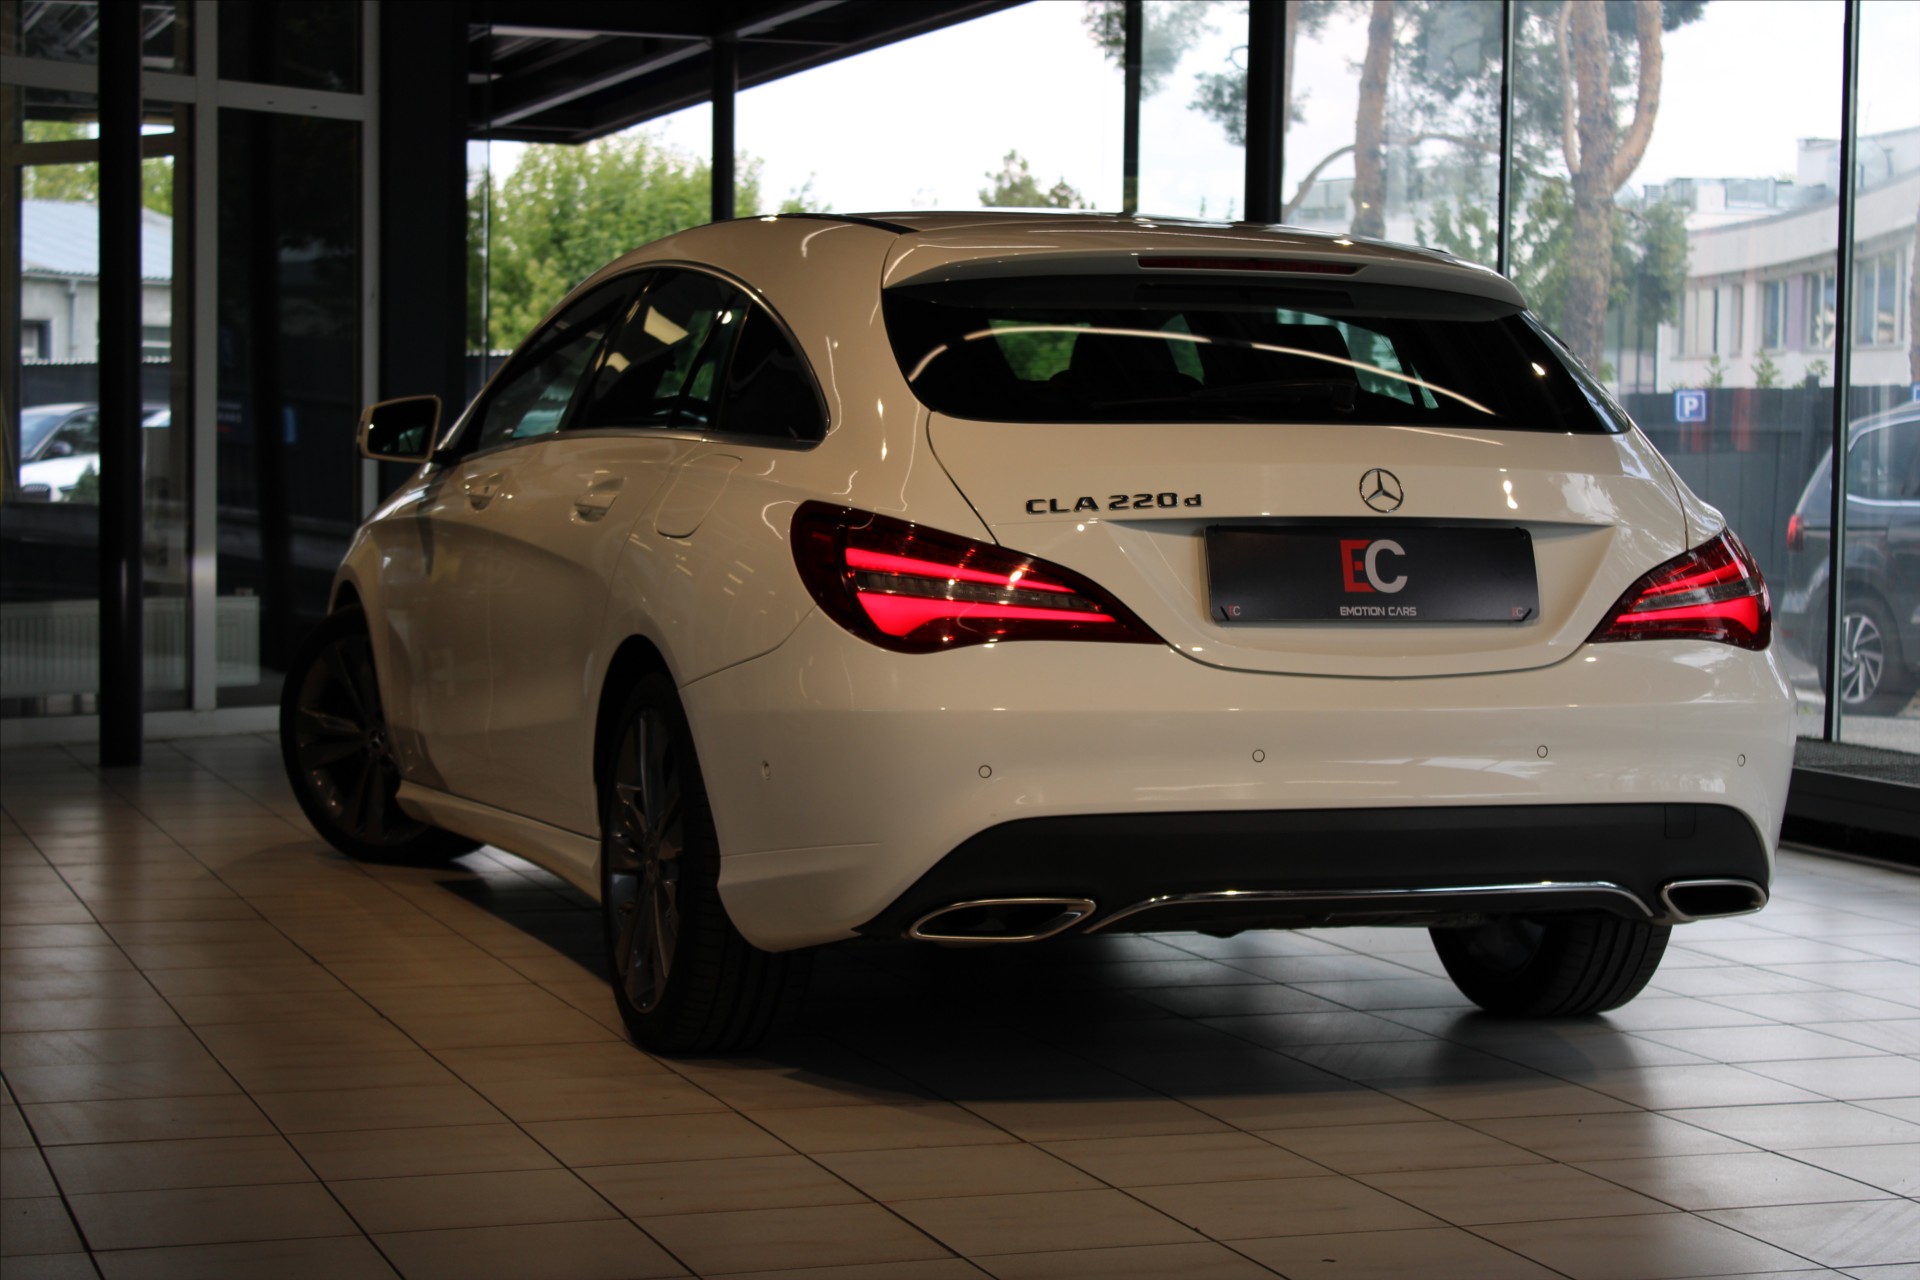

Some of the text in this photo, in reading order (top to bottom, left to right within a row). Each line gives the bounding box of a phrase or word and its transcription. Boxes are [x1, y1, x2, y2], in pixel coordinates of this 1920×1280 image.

[1683, 397, 1699, 417] P
[1026, 496, 1099, 515] CLA
[1340, 539, 1408, 594] EC
[1340, 606, 1417, 617] EMOTION CARS
